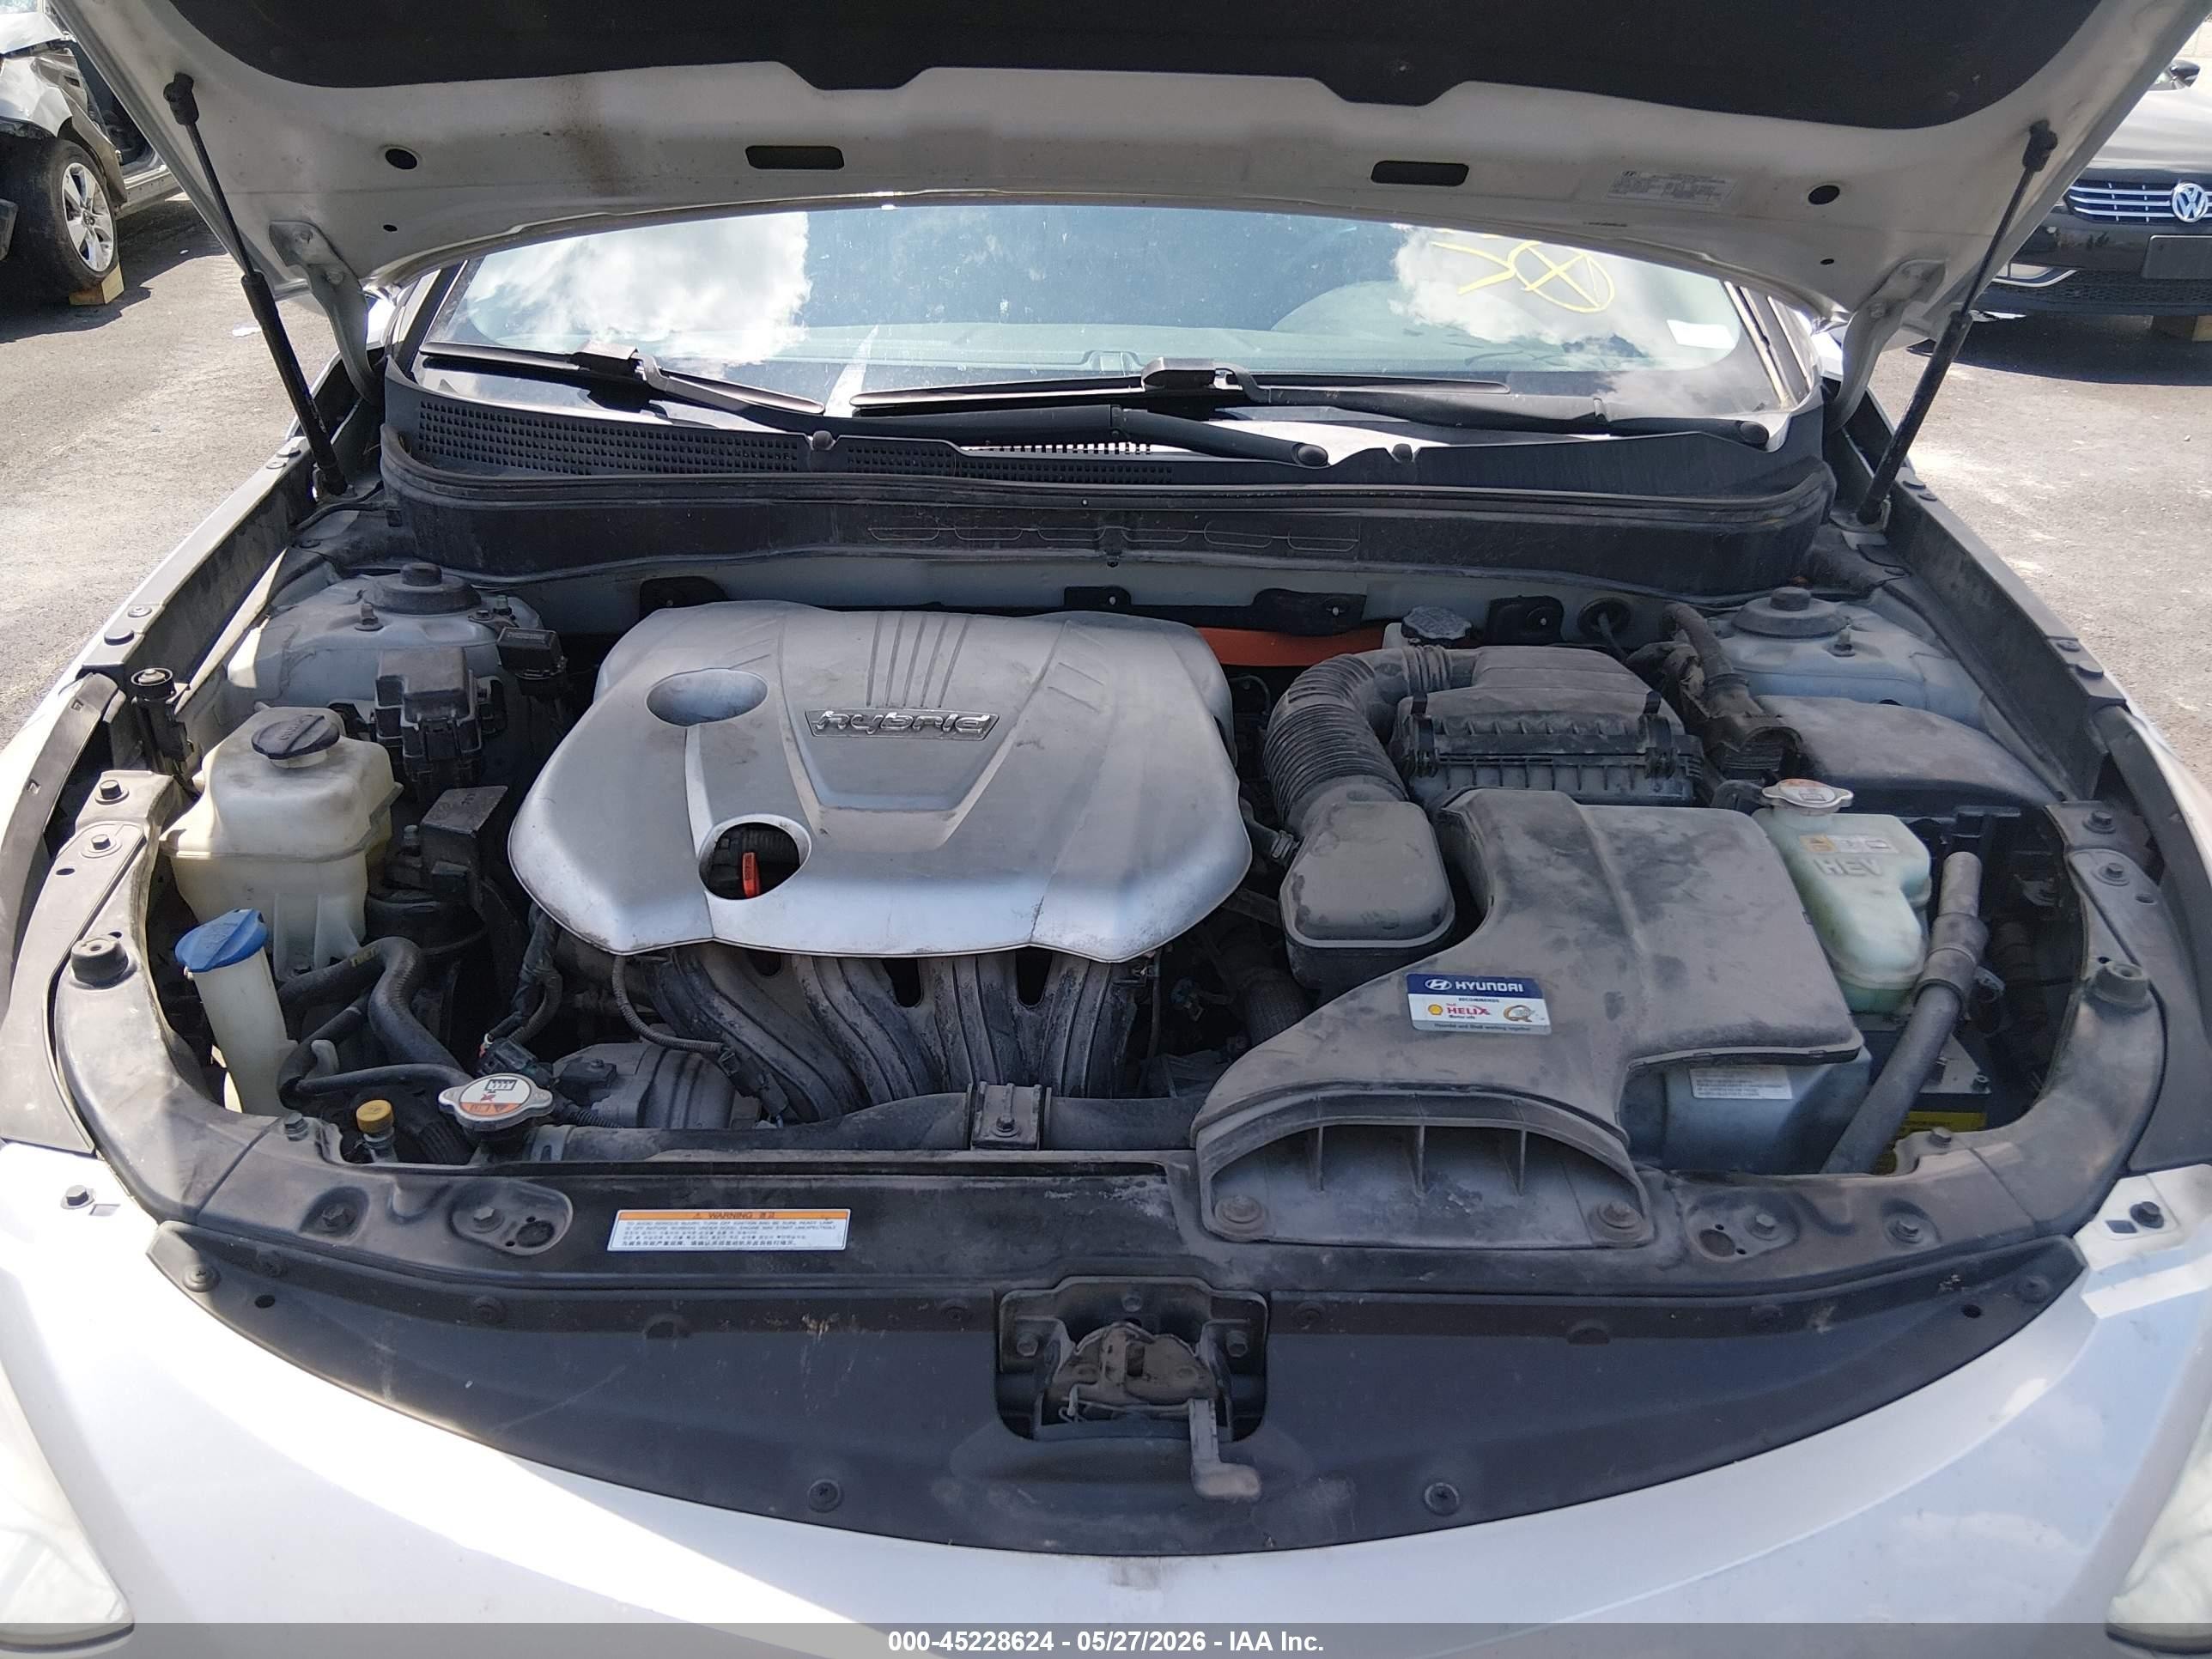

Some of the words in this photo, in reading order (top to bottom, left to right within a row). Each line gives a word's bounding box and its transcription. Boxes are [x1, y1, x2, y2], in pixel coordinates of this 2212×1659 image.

[1814, 859, 1883, 876] HEV
[1455, 981, 1524, 993] HYUNDAI
[1447, 1006, 1491, 1015] HELIX
